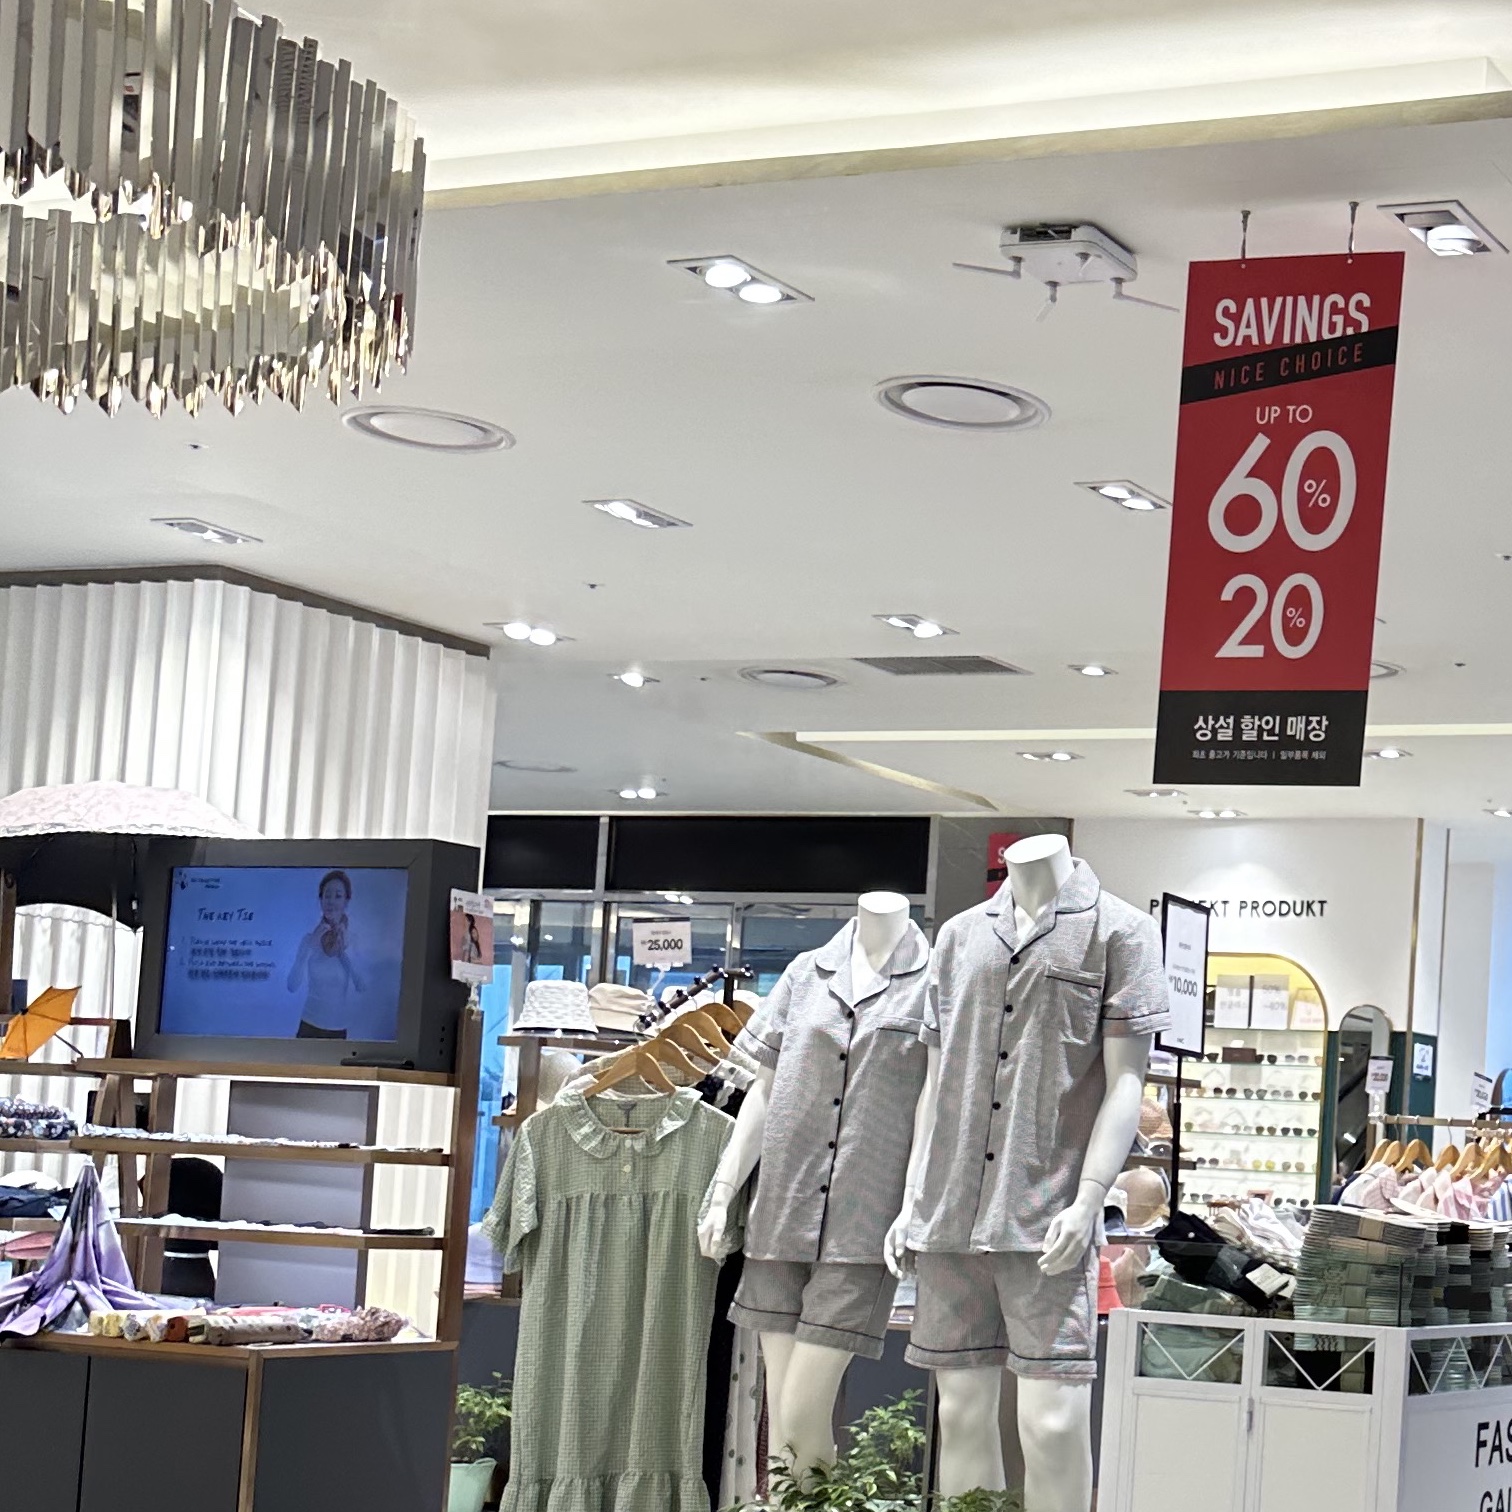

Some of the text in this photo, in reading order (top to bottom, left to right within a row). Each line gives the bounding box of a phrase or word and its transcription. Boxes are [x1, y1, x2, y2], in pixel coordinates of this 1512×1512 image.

[1213, 292, 1371, 347] SAVINGS
[1214, 343, 1363, 390] NICE CHOICE
[1256, 404, 1313, 424] UP TO
[1193, 715, 1329, 741] 상설 할인 매장
[1239, 900, 1327, 918] PRODUKT
